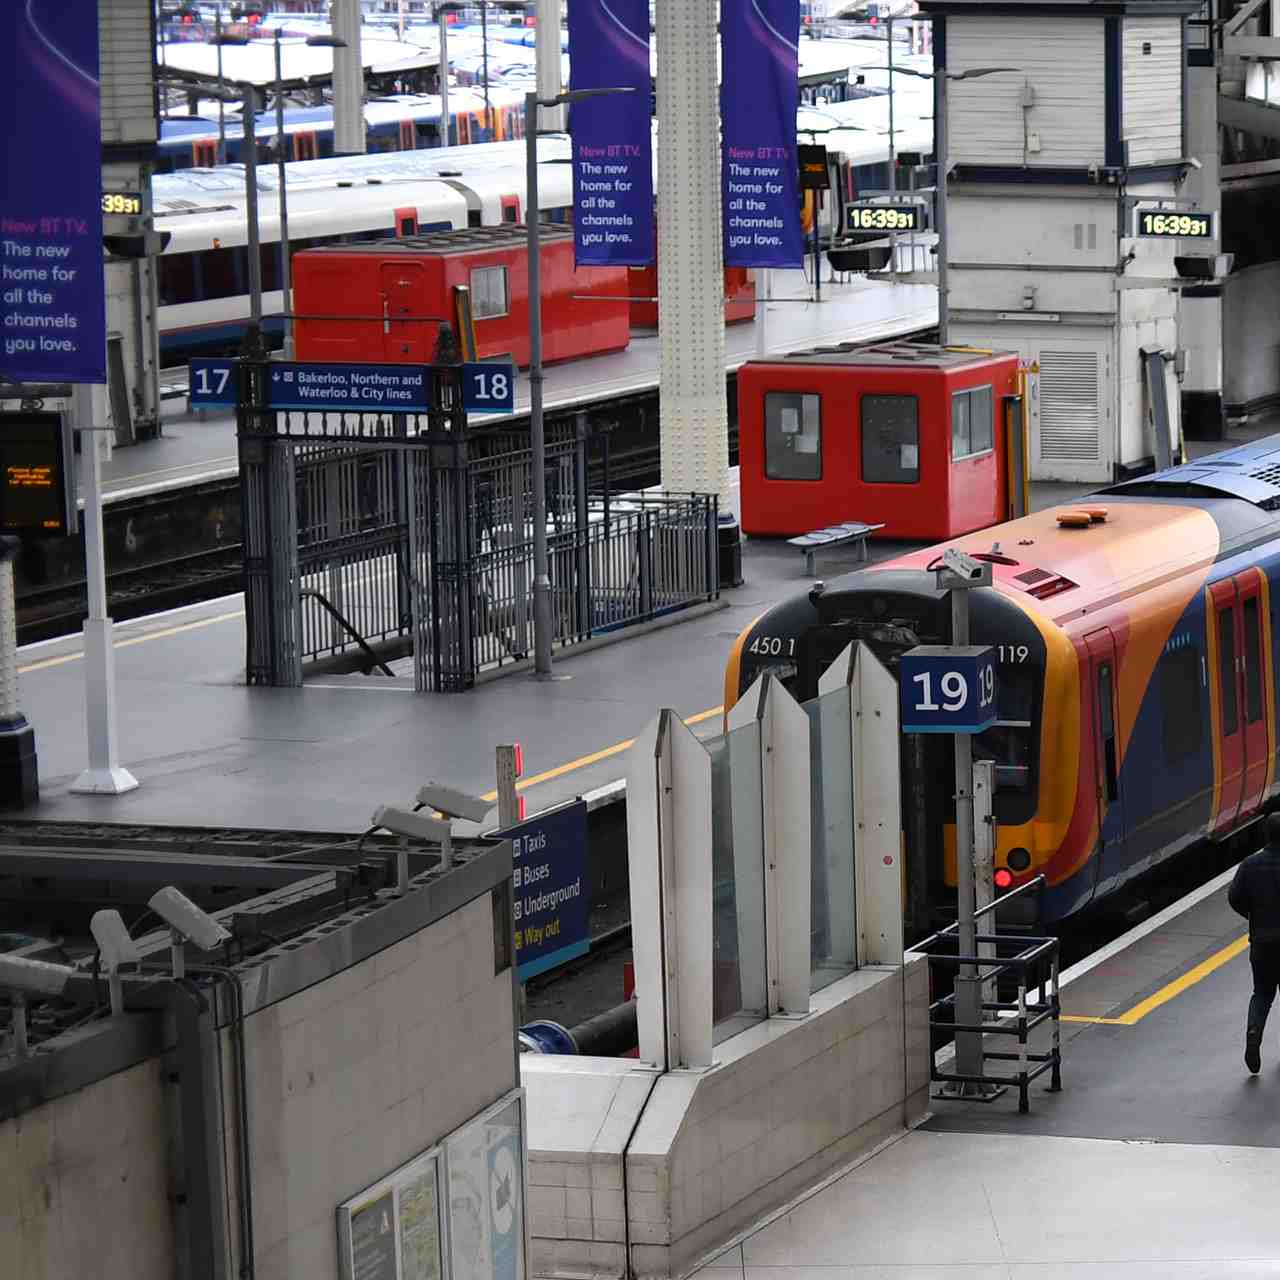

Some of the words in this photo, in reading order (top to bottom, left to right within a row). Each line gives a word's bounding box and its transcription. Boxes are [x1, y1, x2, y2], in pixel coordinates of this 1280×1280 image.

[580, 146, 606, 158] New
[607, 146, 623, 157] BT
[728, 147, 754, 159] New
[757, 148, 771, 159] BT
[580, 162, 602, 175] The
[604, 164, 628, 175] new
[729, 163, 751, 177] The
[753, 166, 779, 177] new
[580, 179, 612, 192] home
[614, 179, 633, 192] for
[728, 181, 763, 194] home
[765, 182, 784, 195] for
[581, 197, 596, 209] all
[597, 197, 616, 209] the
[729, 199, 744, 211] all
[746, 199, 767, 211] the
[0, 216, 37, 234] New
[39, 218, 60, 234] BT
[581, 215, 634, 227] channels
[729, 216, 784, 229] channels
[582, 233, 603, 246] you
[604, 232, 633, 244] love.
[729, 235, 751, 248] you
[753, 234, 783, 246] love.
[3, 240, 32, 257] The
[35, 245, 70, 258] new
[3, 264, 48, 281] home
[51, 265, 77, 282] for
[4, 288, 23, 304] all
[26, 289, 53, 305] the
[4, 312, 78, 329] channels
[5, 338, 36, 355] you
[39, 336, 77, 352] love.
[194, 367, 231, 396] 17
[298, 371, 349, 387] Bakerloo,
[350, 372, 401, 387] Northern
[402, 373, 423, 387] and
[473, 372, 509, 400] 18
[298, 385, 349, 399] Waterloo
[350, 387, 361, 400] &
[361, 387, 385, 401] City
[386, 388, 413, 400] lines
[749, 636, 782, 656] 450
[787, 638, 796, 656] 1
[997, 645, 1029, 664] 119
[913, 671, 968, 712] 19
[979, 663, 995, 708] 19
[523, 832, 546, 854] Taxis
[524, 864, 550, 886] Buses
[524, 875, 581, 917] Underground
[524, 925, 544, 946] Way
[545, 919, 561, 938] out
